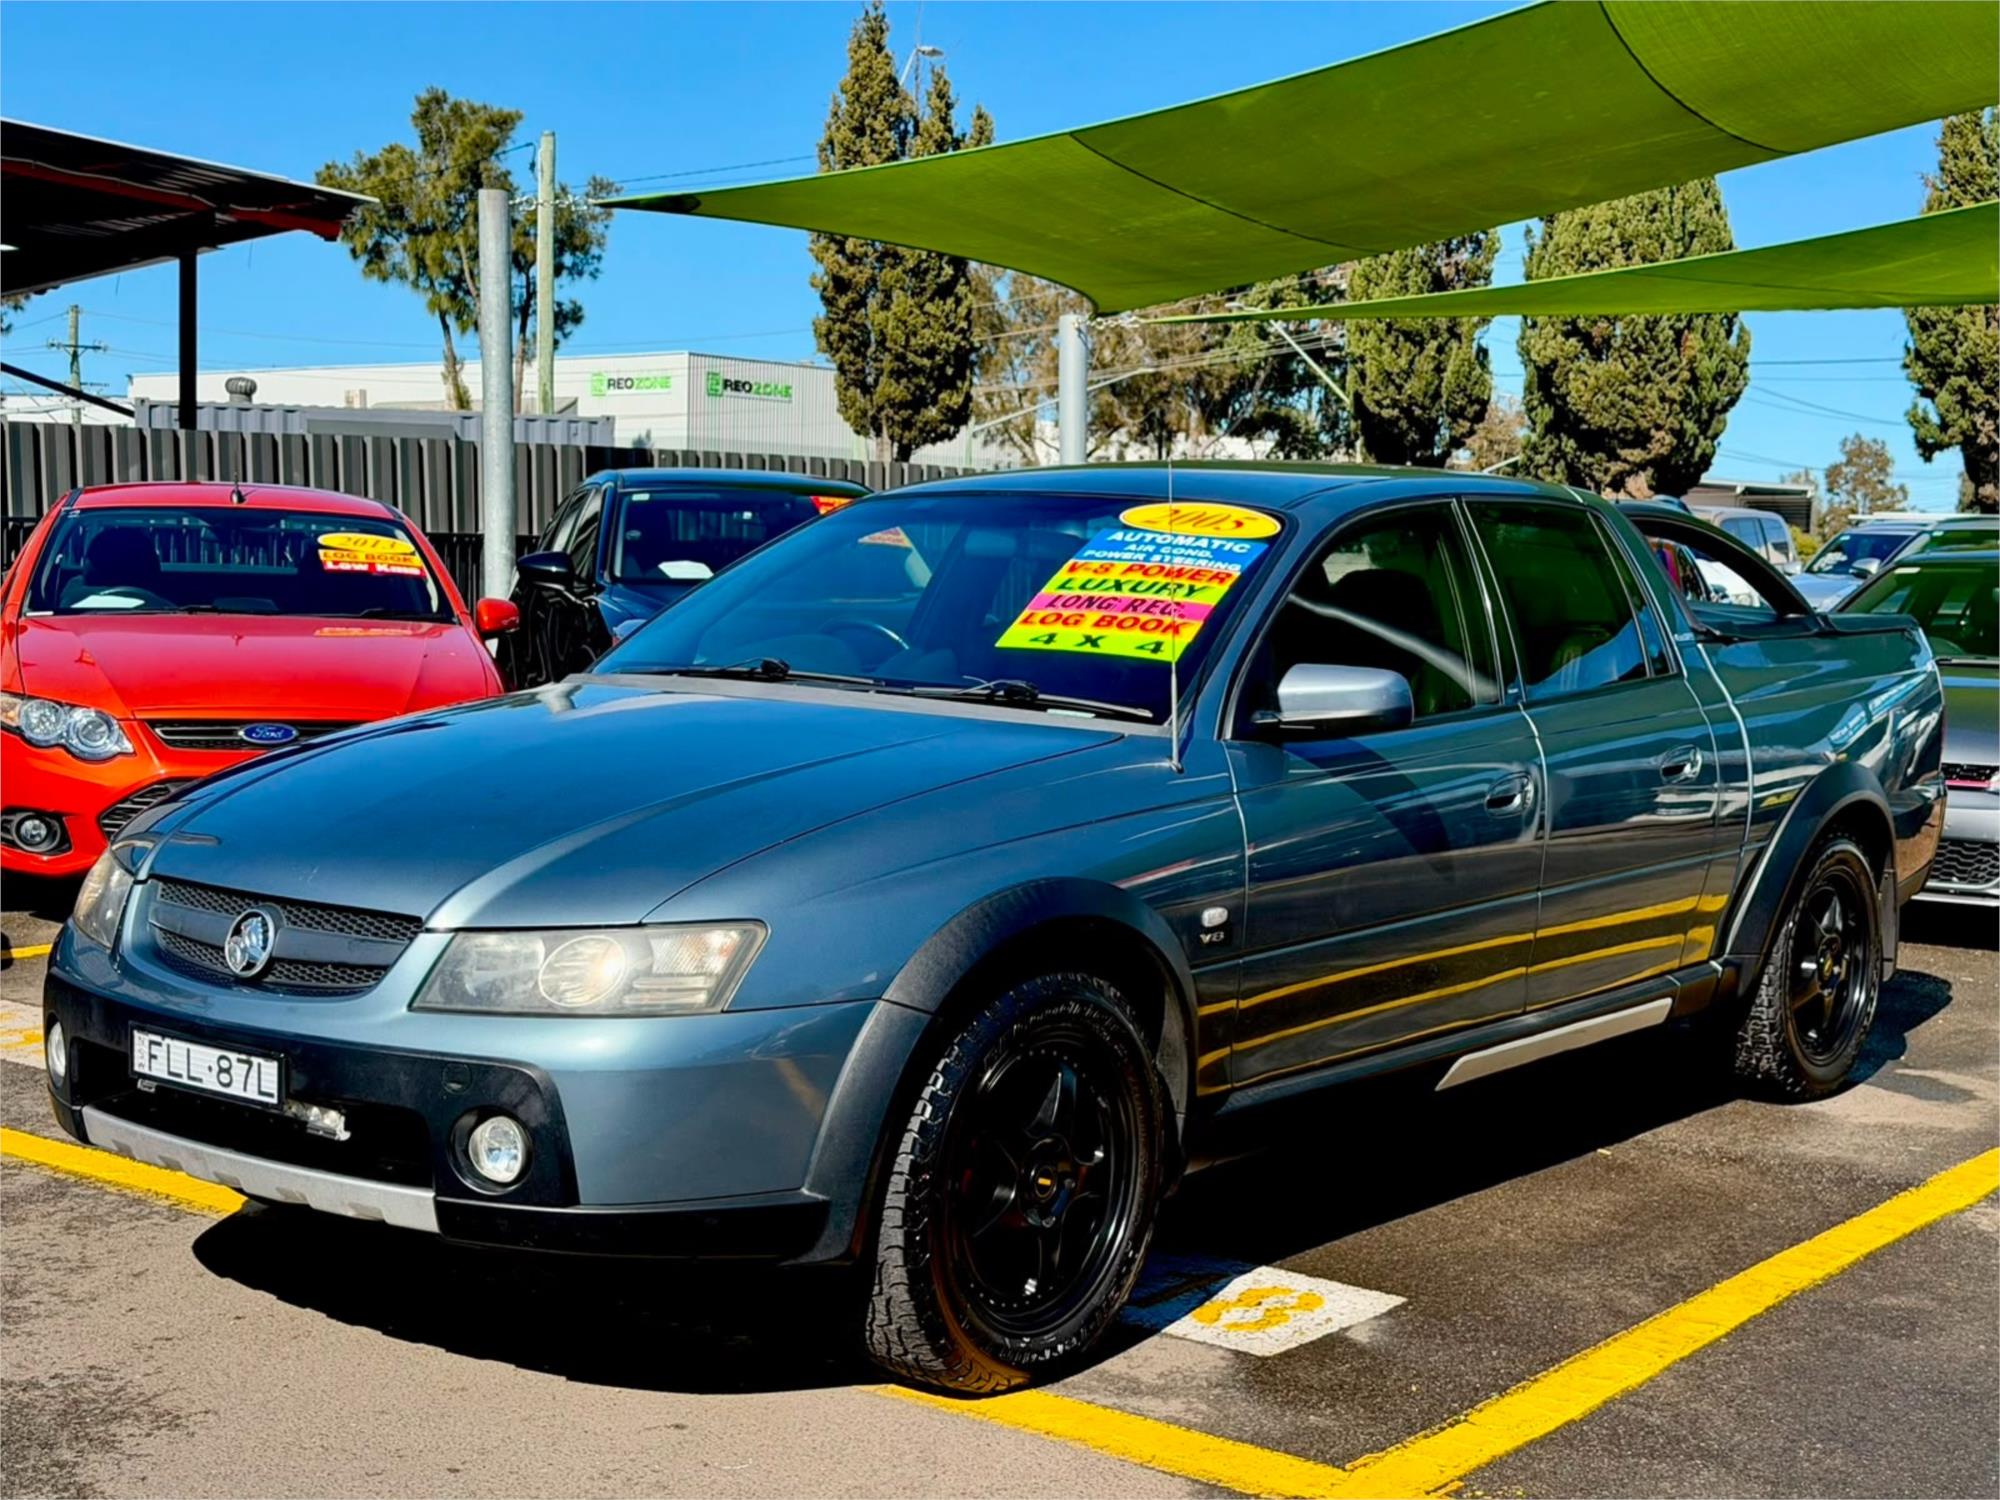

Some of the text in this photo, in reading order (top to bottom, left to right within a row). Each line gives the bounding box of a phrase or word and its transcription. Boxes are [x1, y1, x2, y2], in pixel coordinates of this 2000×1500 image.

[607, 375, 672, 390] REOZONE
[722, 378, 793, 399] REOZONE
[1142, 509, 1258, 531] 2005
[1106, 531, 1251, 554] AUTOMATIC
[1124, 543, 1156, 553] AIR
[323, 551, 413, 563] LOG BOOK
[1083, 550, 1242, 572] POWER STEERING
[1123, 562, 1235, 586] POWER
[1056, 576, 1210, 598] LUXURY
[1044, 594, 1121, 611] LONG
[1019, 612, 1195, 637] LOG BOOK
[1030, 633, 1165, 654] 4 X 4
[1199, 931, 1225, 944] V8
